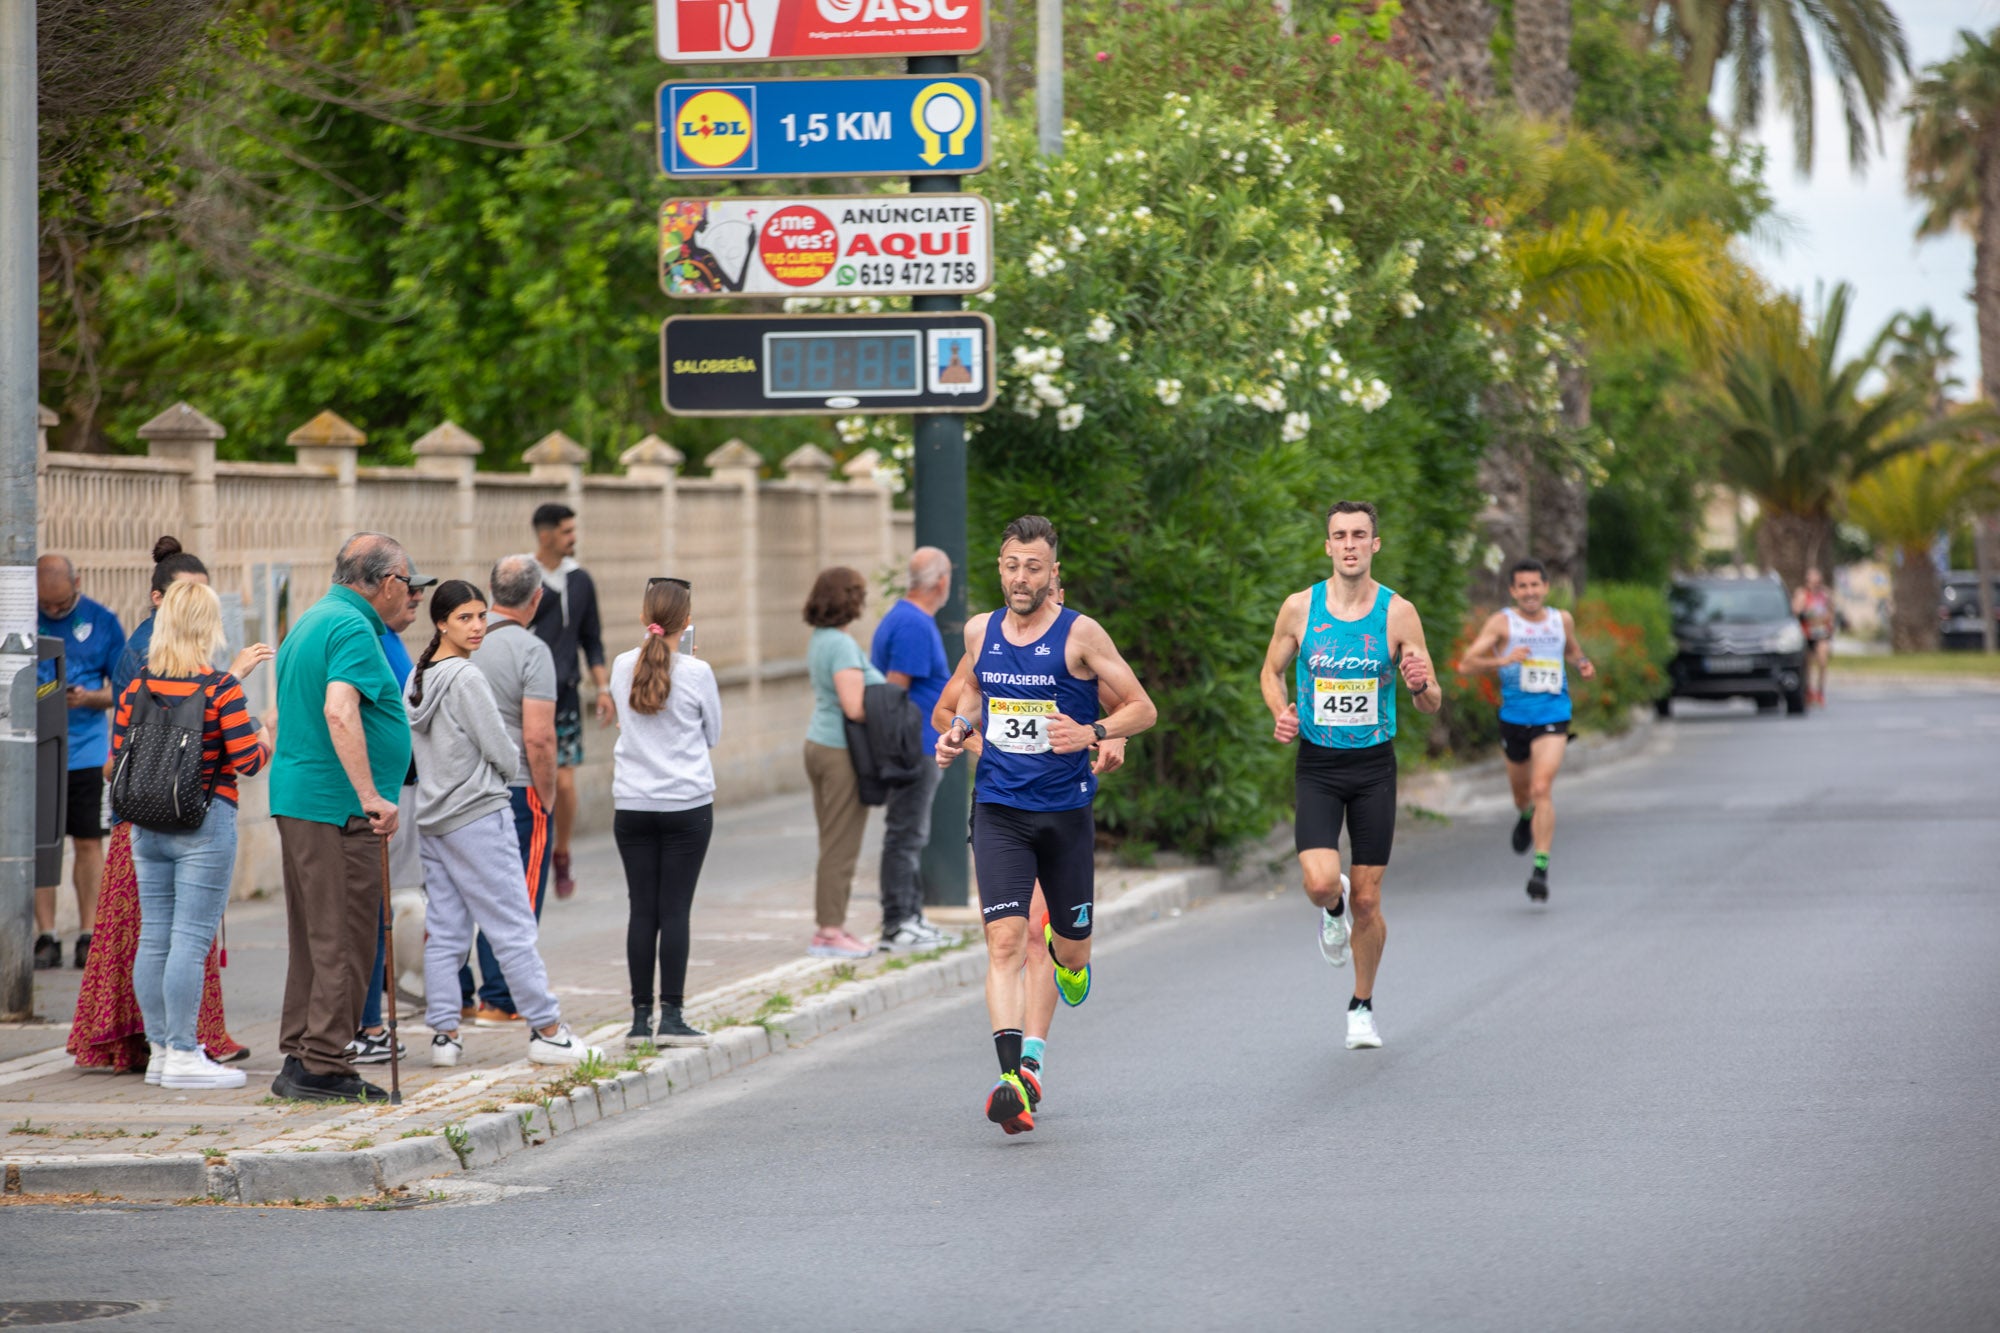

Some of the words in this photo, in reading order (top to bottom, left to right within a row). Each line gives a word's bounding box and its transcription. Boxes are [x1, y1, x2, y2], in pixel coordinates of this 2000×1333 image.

[780, 113, 829, 148] 1,5
[837, 111, 892, 142] KM
[841, 204, 977, 225] ANÚNCIATE
[767, 215, 816, 237] ¿me
[783, 229, 836, 250] ves?
[846, 225, 972, 259] AQUÍ
[860, 263, 893, 286] 619
[901, 262, 936, 285] 472
[942, 261, 977, 285] 758
[672, 355, 757, 375] SALOBREÑA
[982, 672, 1056, 685] TROTASIERRA
[1527, 670, 1559, 685] 575
[1323, 696, 1368, 714] 452
[1004, 719, 1038, 740] 34
